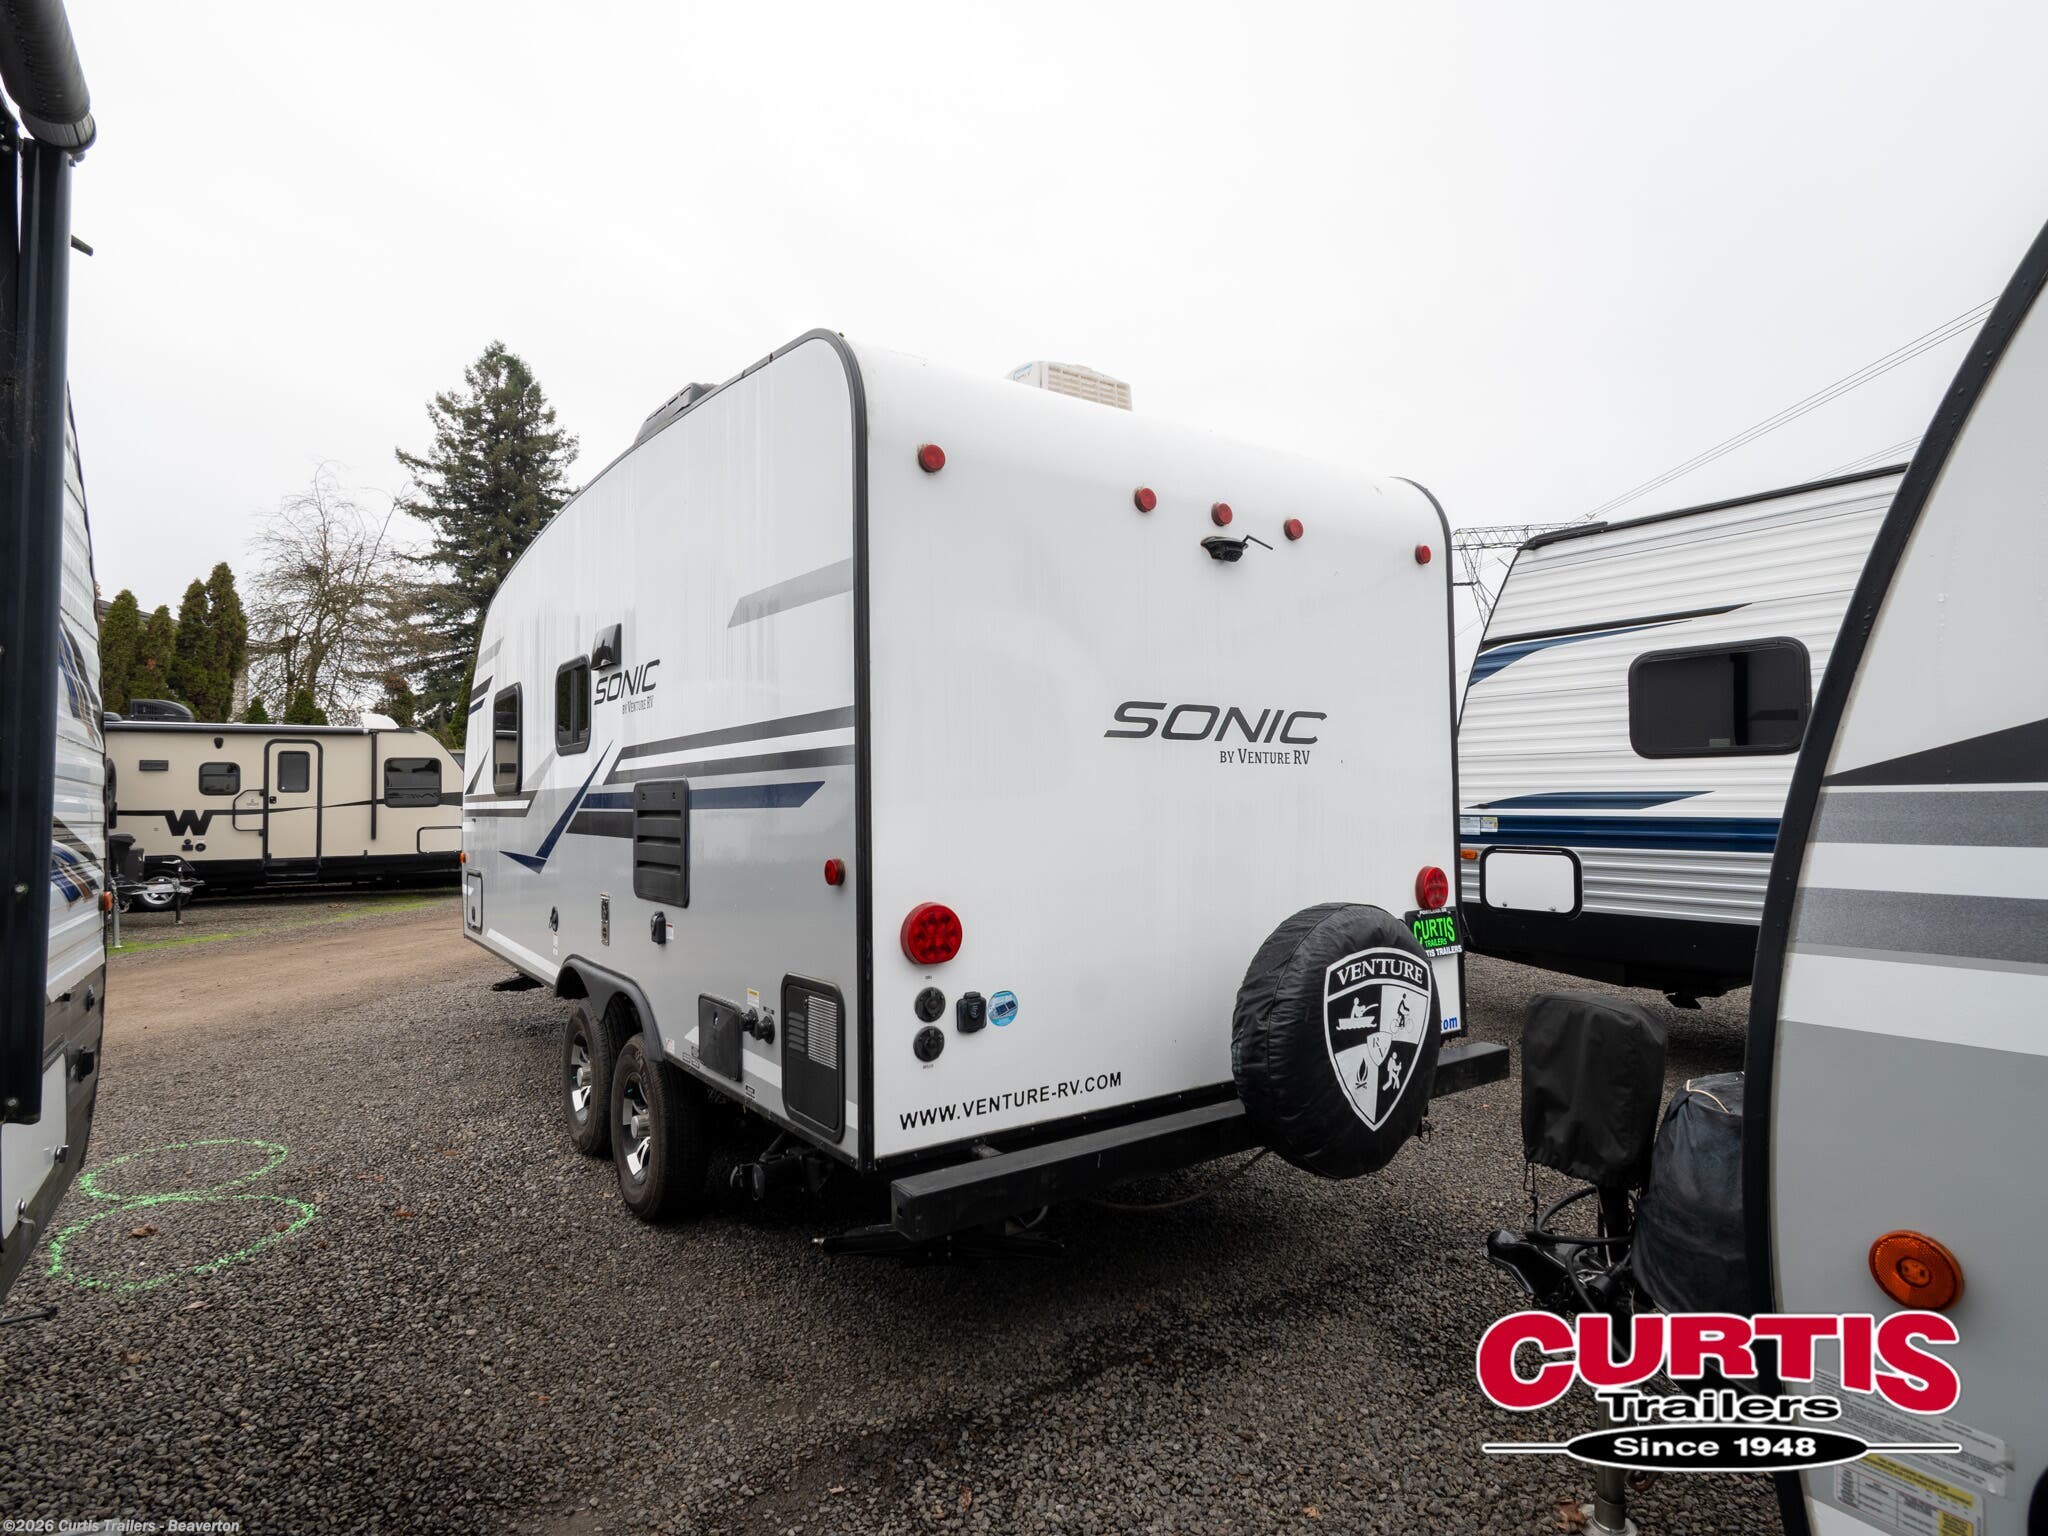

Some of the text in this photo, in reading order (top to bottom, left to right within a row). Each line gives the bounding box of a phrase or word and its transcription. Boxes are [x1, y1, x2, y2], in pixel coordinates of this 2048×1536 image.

[594, 659, 661, 705] SONIC
[1103, 700, 1328, 745] SONIC
[1293, 749, 1311, 765] RV
[165, 809, 213, 836] W
[1413, 916, 1456, 945] CURTIS
[1425, 937, 1448, 947] TRAILERS
[1436, 944, 1463, 956] TRAILERS
[1337, 958, 1424, 985] VENTURE
[1440, 1016, 1458, 1031] om
[899, 1071, 1122, 1130] WWW.VENTURE-RV.COM
